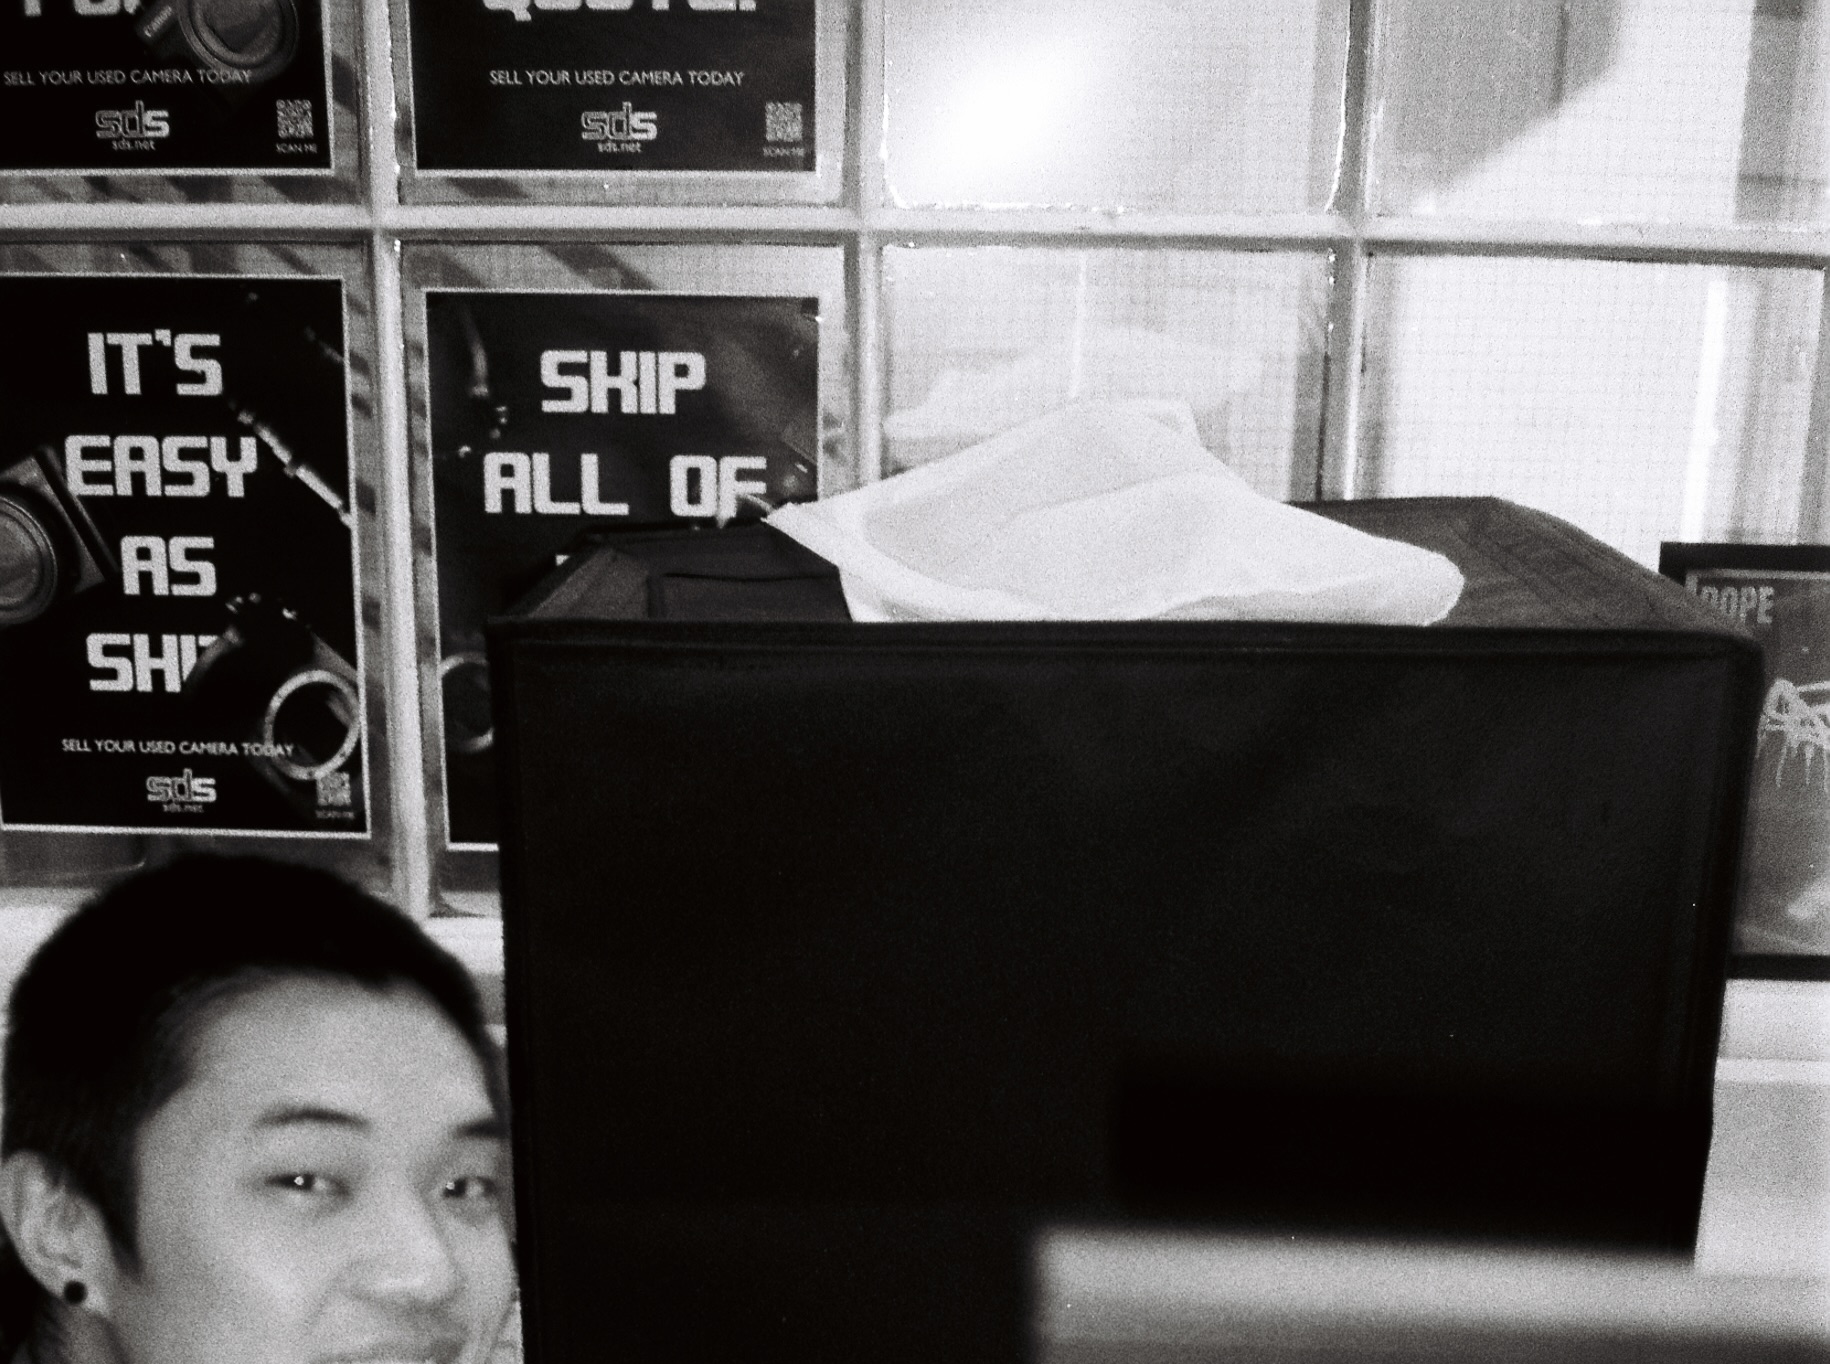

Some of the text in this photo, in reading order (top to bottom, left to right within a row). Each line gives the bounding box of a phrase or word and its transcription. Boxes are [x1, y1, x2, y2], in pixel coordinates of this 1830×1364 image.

[3, 68, 252, 86] SELL YOUR USED CAMERA TODAY
[489, 70, 745, 86] SELL YOUR USED CAMERA TODAY
[95, 100, 171, 138] sds
[581, 101, 658, 141] sds
[112, 139, 156, 151] sds.net
[276, 143, 303, 154] SCAN
[597, 140, 643, 153] sds.net
[87, 328, 224, 396] IT'S
[540, 349, 707, 415] SKIP
[64, 434, 259, 498] EASY
[482, 451, 768, 520] ALL OF
[119, 535, 218, 597] AS
[61, 738, 295, 758] SELL YOUR USED CAMERA TODAY
[145, 767, 218, 803] sds
